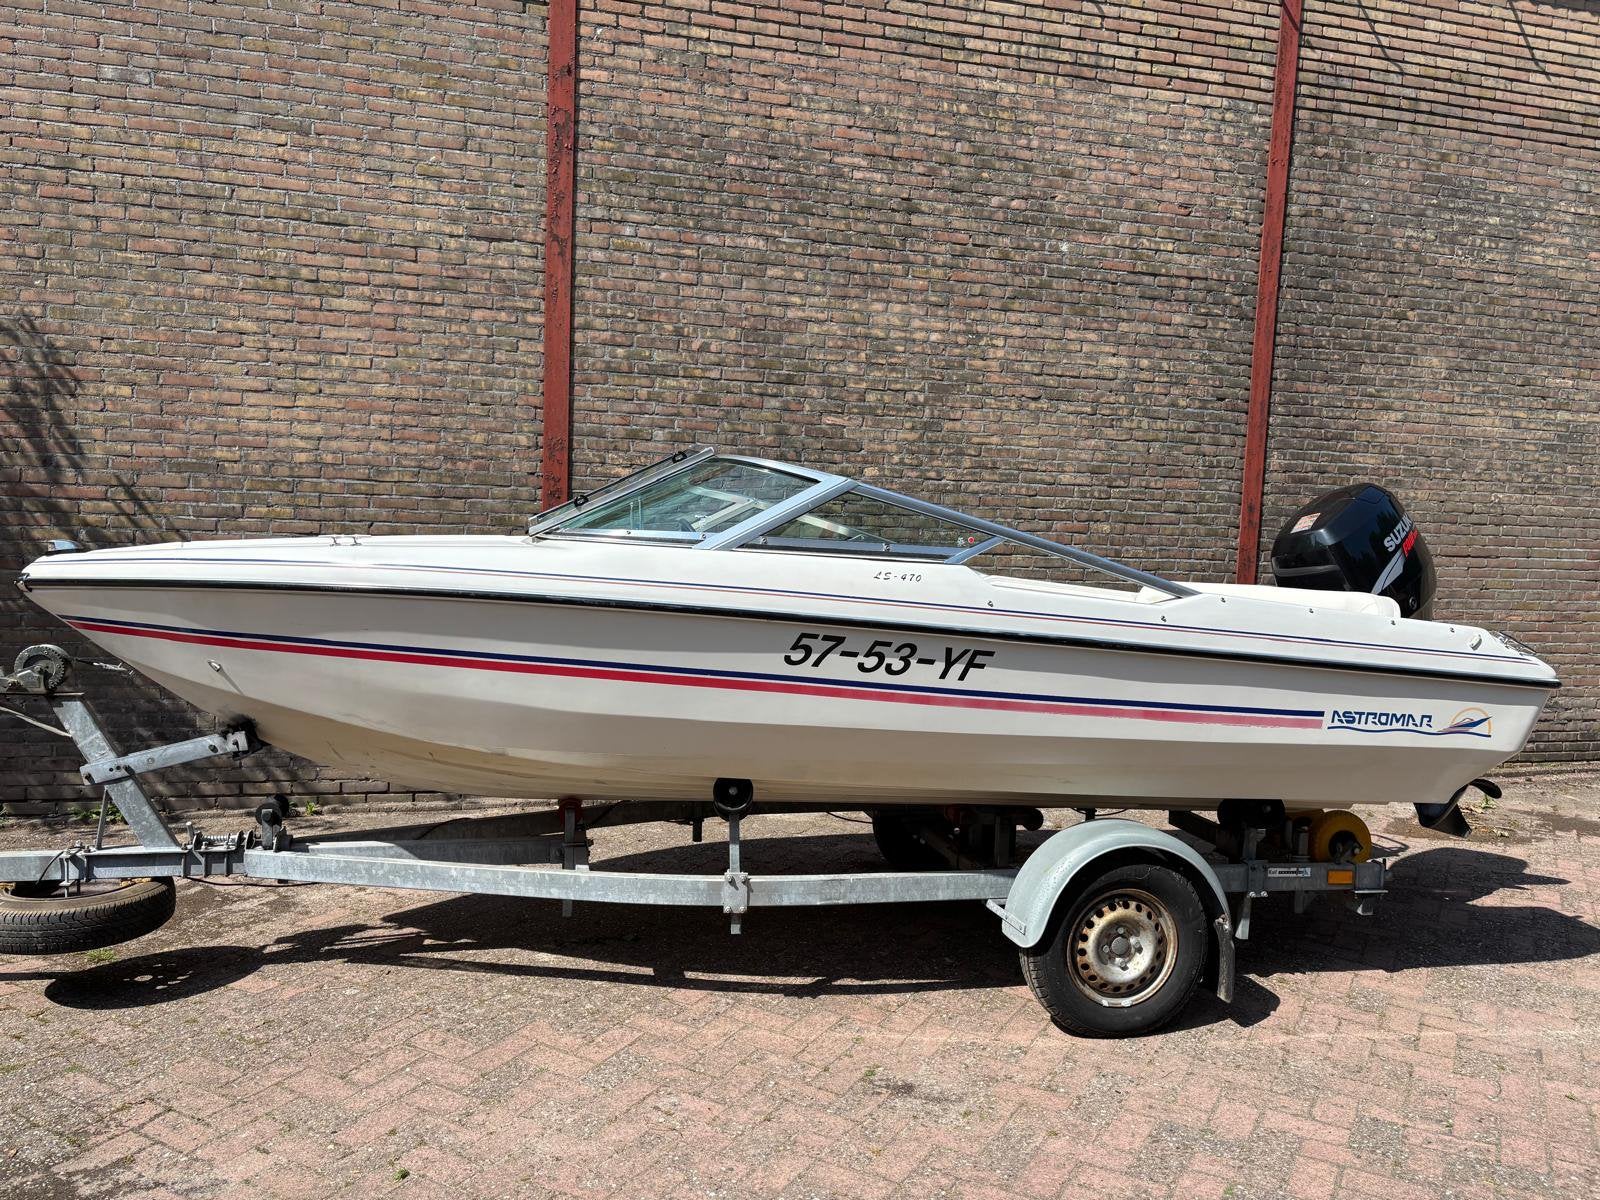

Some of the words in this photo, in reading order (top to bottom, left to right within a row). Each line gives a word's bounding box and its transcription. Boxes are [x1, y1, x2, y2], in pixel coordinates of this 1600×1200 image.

[1384, 512, 1411, 552] SUZUK
[873, 571, 922, 582] LS-470
[784, 632, 995, 681] 57-53-YF
[1331, 710, 1433, 728] ASTROMAR
